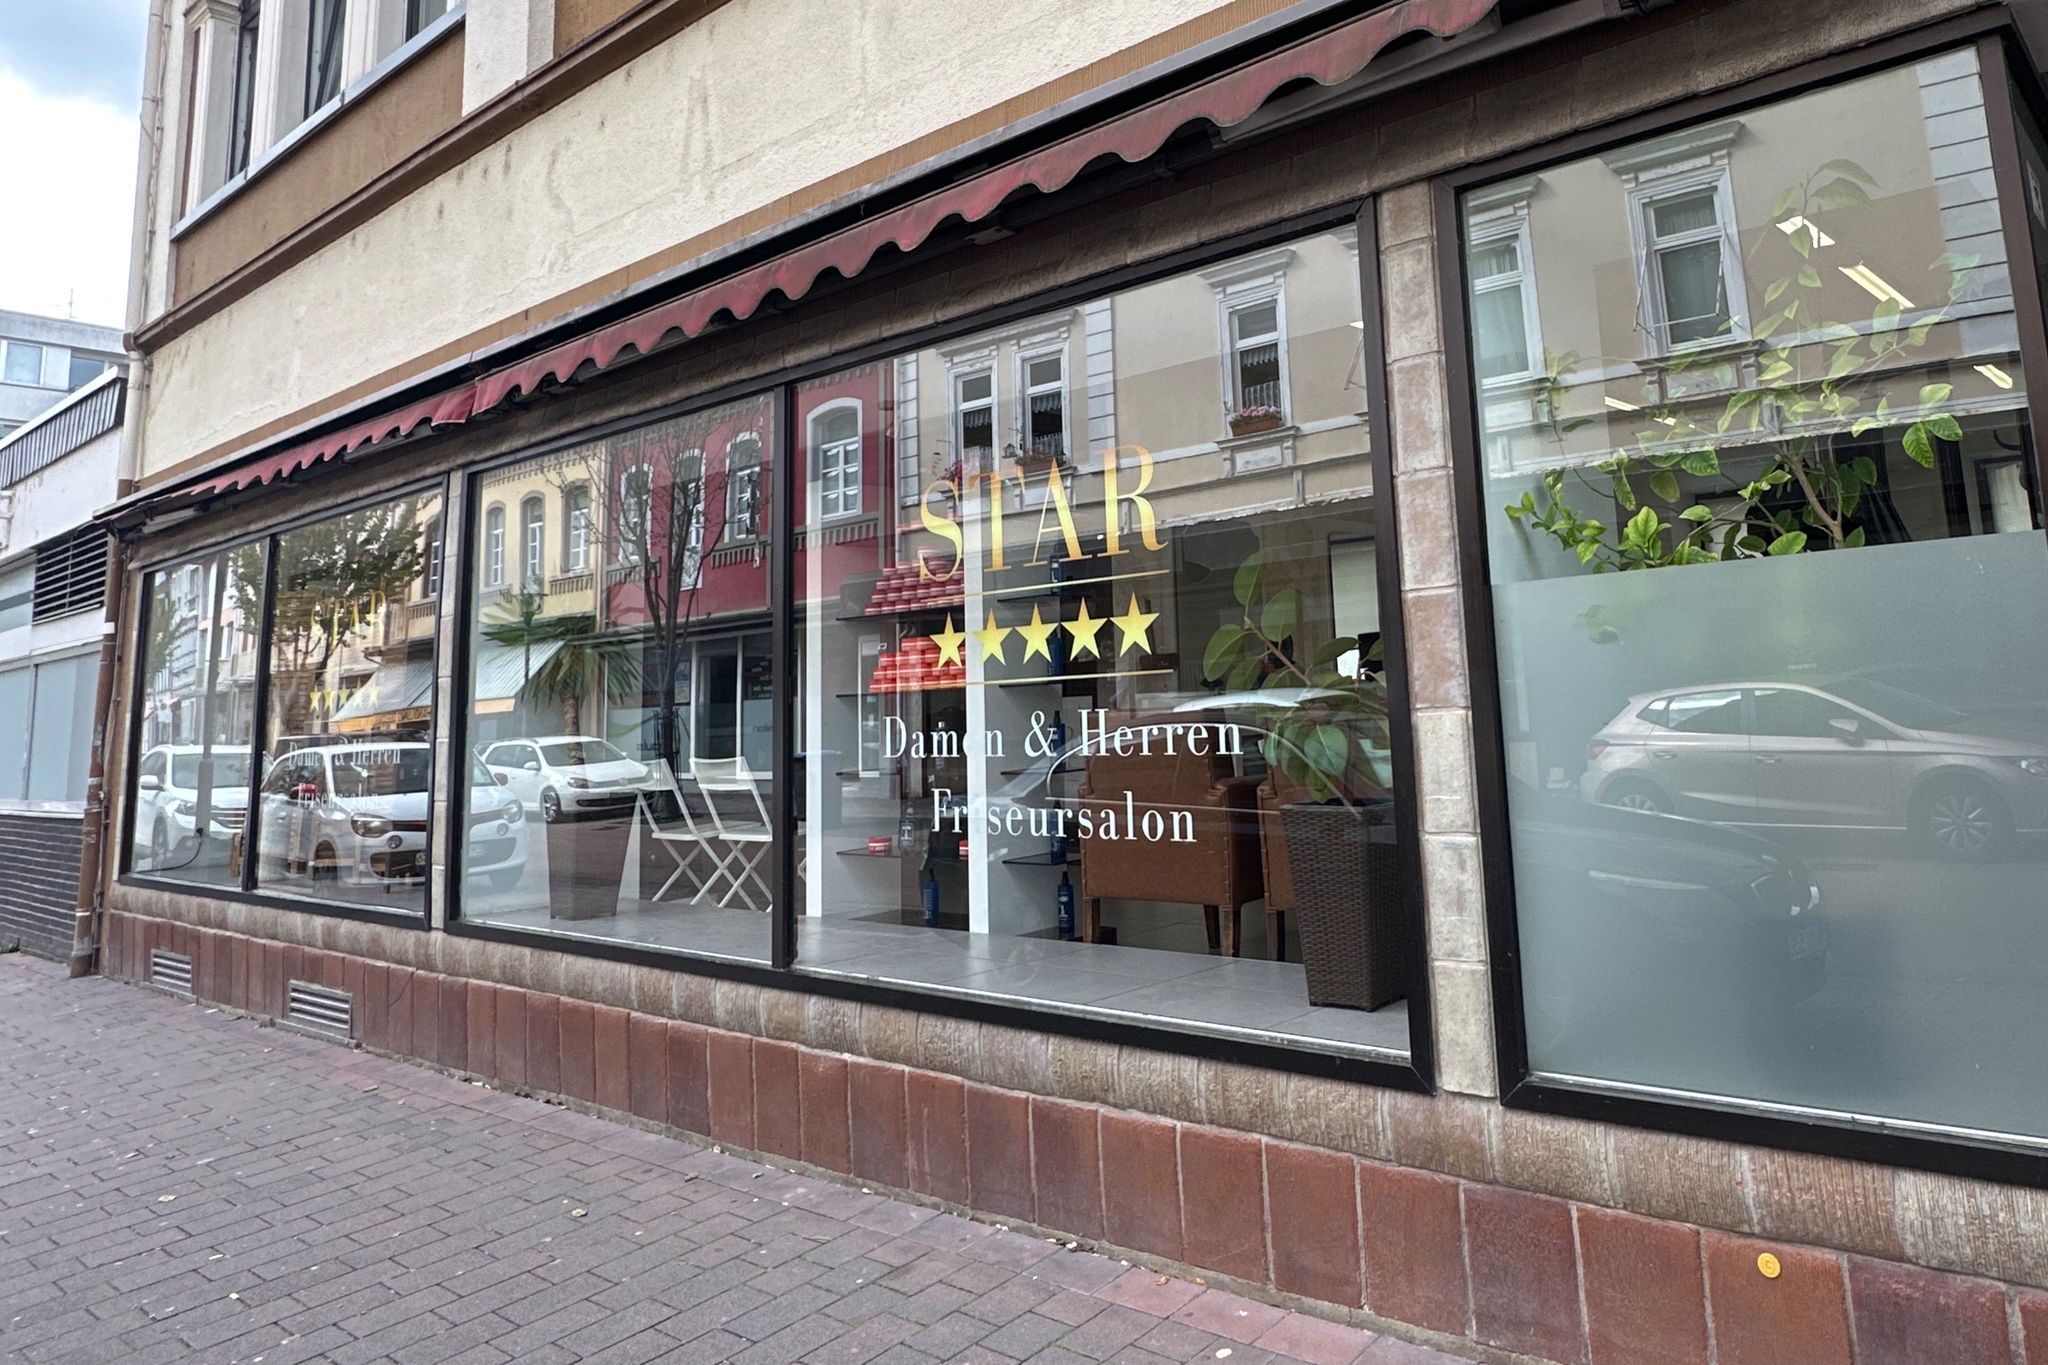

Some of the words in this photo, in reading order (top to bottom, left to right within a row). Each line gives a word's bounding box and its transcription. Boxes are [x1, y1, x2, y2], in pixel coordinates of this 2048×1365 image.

[918, 444, 1169, 583] STAR
[288, 741, 331, 768] Dame
[352, 739, 401, 766] Herren
[1024, 710, 1058, 758] &
[1078, 708, 1244, 757] Herren
[297, 782, 379, 810] Friseulon
[931, 788, 1198, 843] Frseursalon
